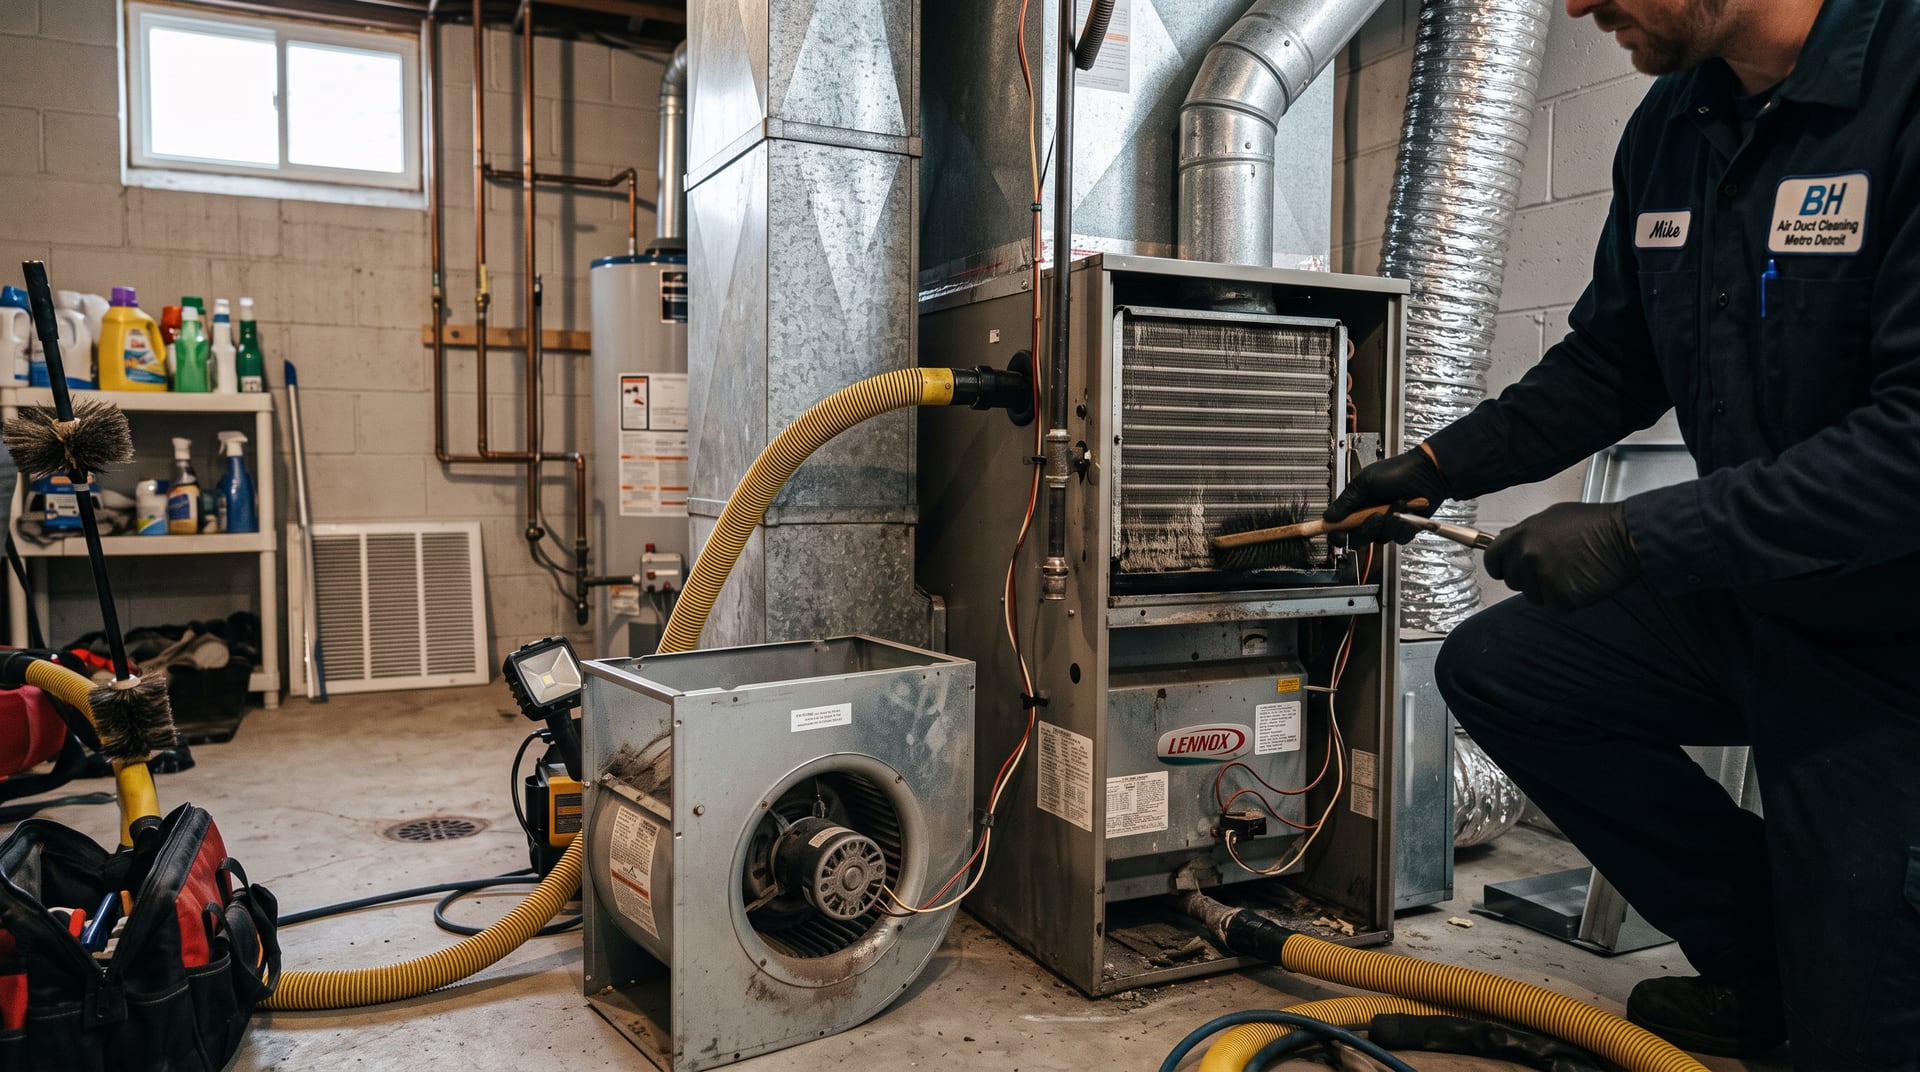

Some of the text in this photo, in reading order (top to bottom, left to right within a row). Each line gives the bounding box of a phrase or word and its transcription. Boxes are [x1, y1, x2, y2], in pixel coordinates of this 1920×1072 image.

[1799, 182, 1848, 216] BH
[1649, 220, 1681, 239] Mike
[1777, 218, 1859, 234] Air Duct Cleaning
[1784, 234, 1846, 246] Metro Detroit
[1168, 732, 1230, 755] LENNOX
